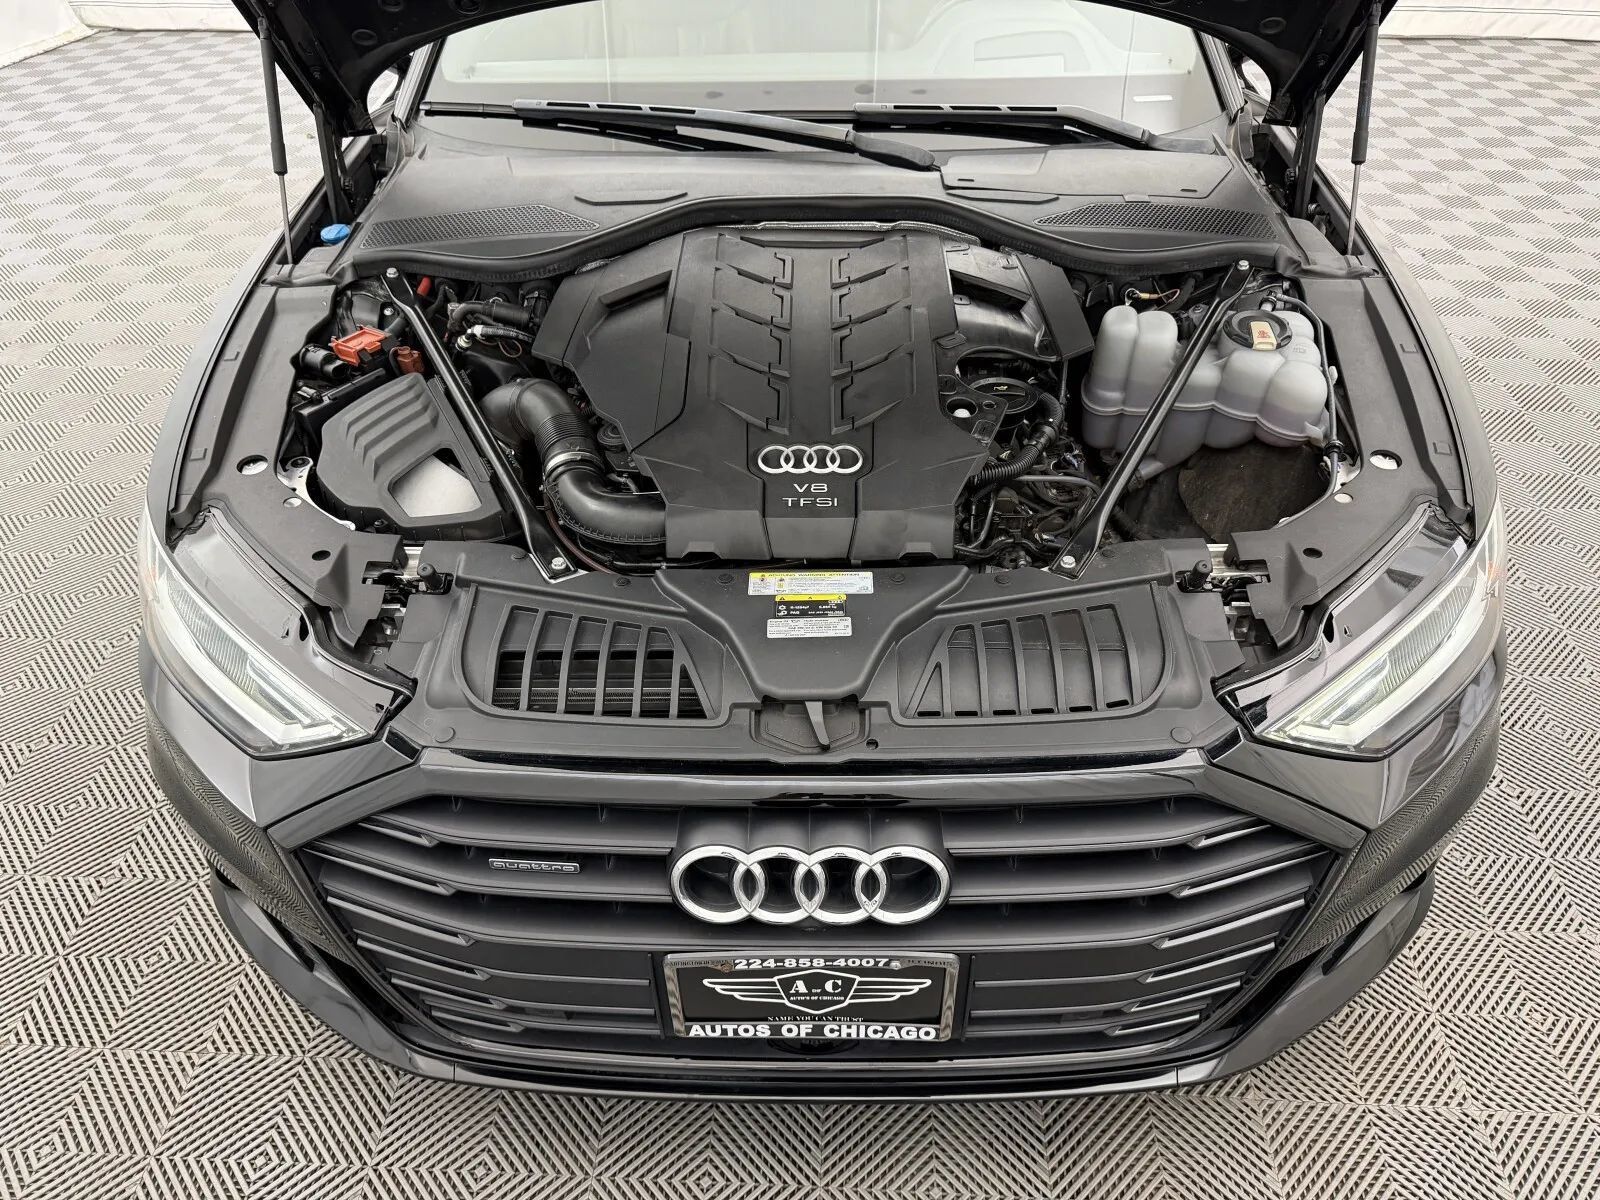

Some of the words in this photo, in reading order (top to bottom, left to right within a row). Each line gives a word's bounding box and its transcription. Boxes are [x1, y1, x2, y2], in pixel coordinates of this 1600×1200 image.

[793, 483, 828, 493] V8
[782, 497, 838, 507] TFSI
[493, 862, 575, 872] quattro
[735, 958, 889, 969] 224-858-4007
[789, 980, 809, 994] A
[824, 979, 842, 993] C
[688, 1024, 771, 1037] AUTOS
[781, 1023, 813, 1037] OF
[823, 1024, 937, 1040] CHICAGO
